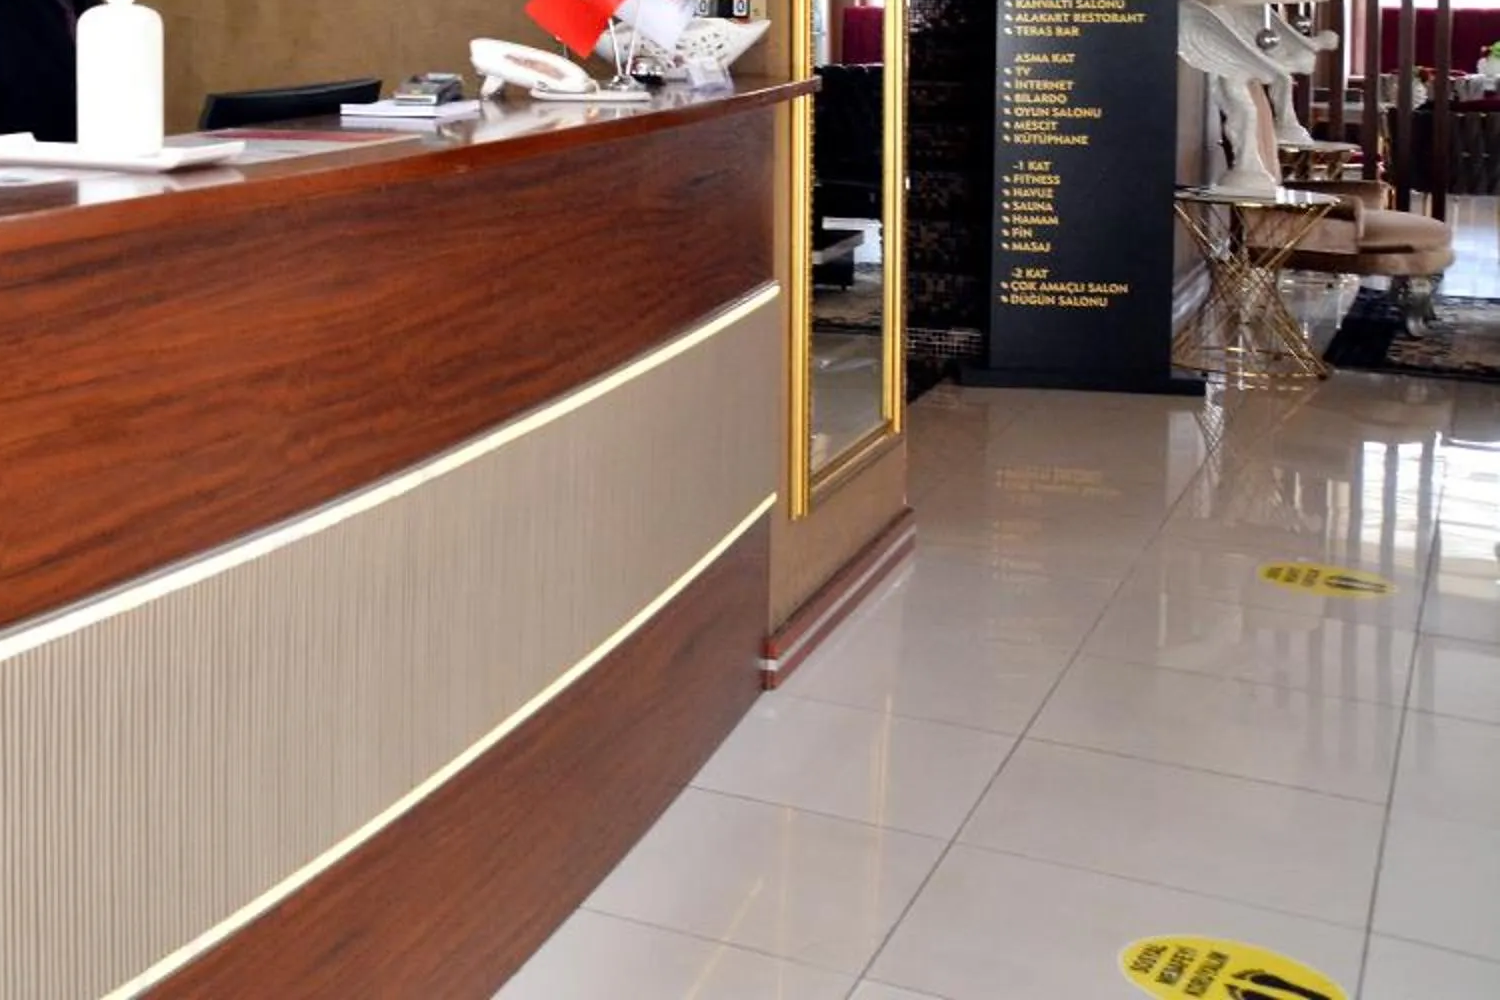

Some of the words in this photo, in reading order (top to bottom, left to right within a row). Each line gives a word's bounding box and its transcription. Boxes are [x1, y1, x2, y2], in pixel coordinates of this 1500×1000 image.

[1015, 0, 1073, 9] KAHVALTI
[1076, 0, 1126, 10] SALONU
[1015, 13, 1069, 23] ALAKART
[1015, 26, 1053, 37] TERAS
[1056, 27, 1081, 37] BAR
[1015, 53, 1050, 63] ASMA
[1051, 53, 1076, 63] KAT
[1015, 66, 1031, 77] TV
[1014, 107, 1049, 118] OYUN
[1051, 107, 1102, 119] SALONU
[1013, 132, 1090, 145] KÜTÜPHANE
[1027, 160, 1052, 172] KAT
[1012, 187, 1054, 199] HAVUZ
[1012, 201, 1053, 212] SAUNA
[1012, 214, 1059, 226] HAMAM
[1011, 241, 1051, 253] MASAJ
[1025, 267, 1050, 279] KAT
[1088, 283, 1129, 294] SALON
[1058, 296, 1108, 308] SALONU
